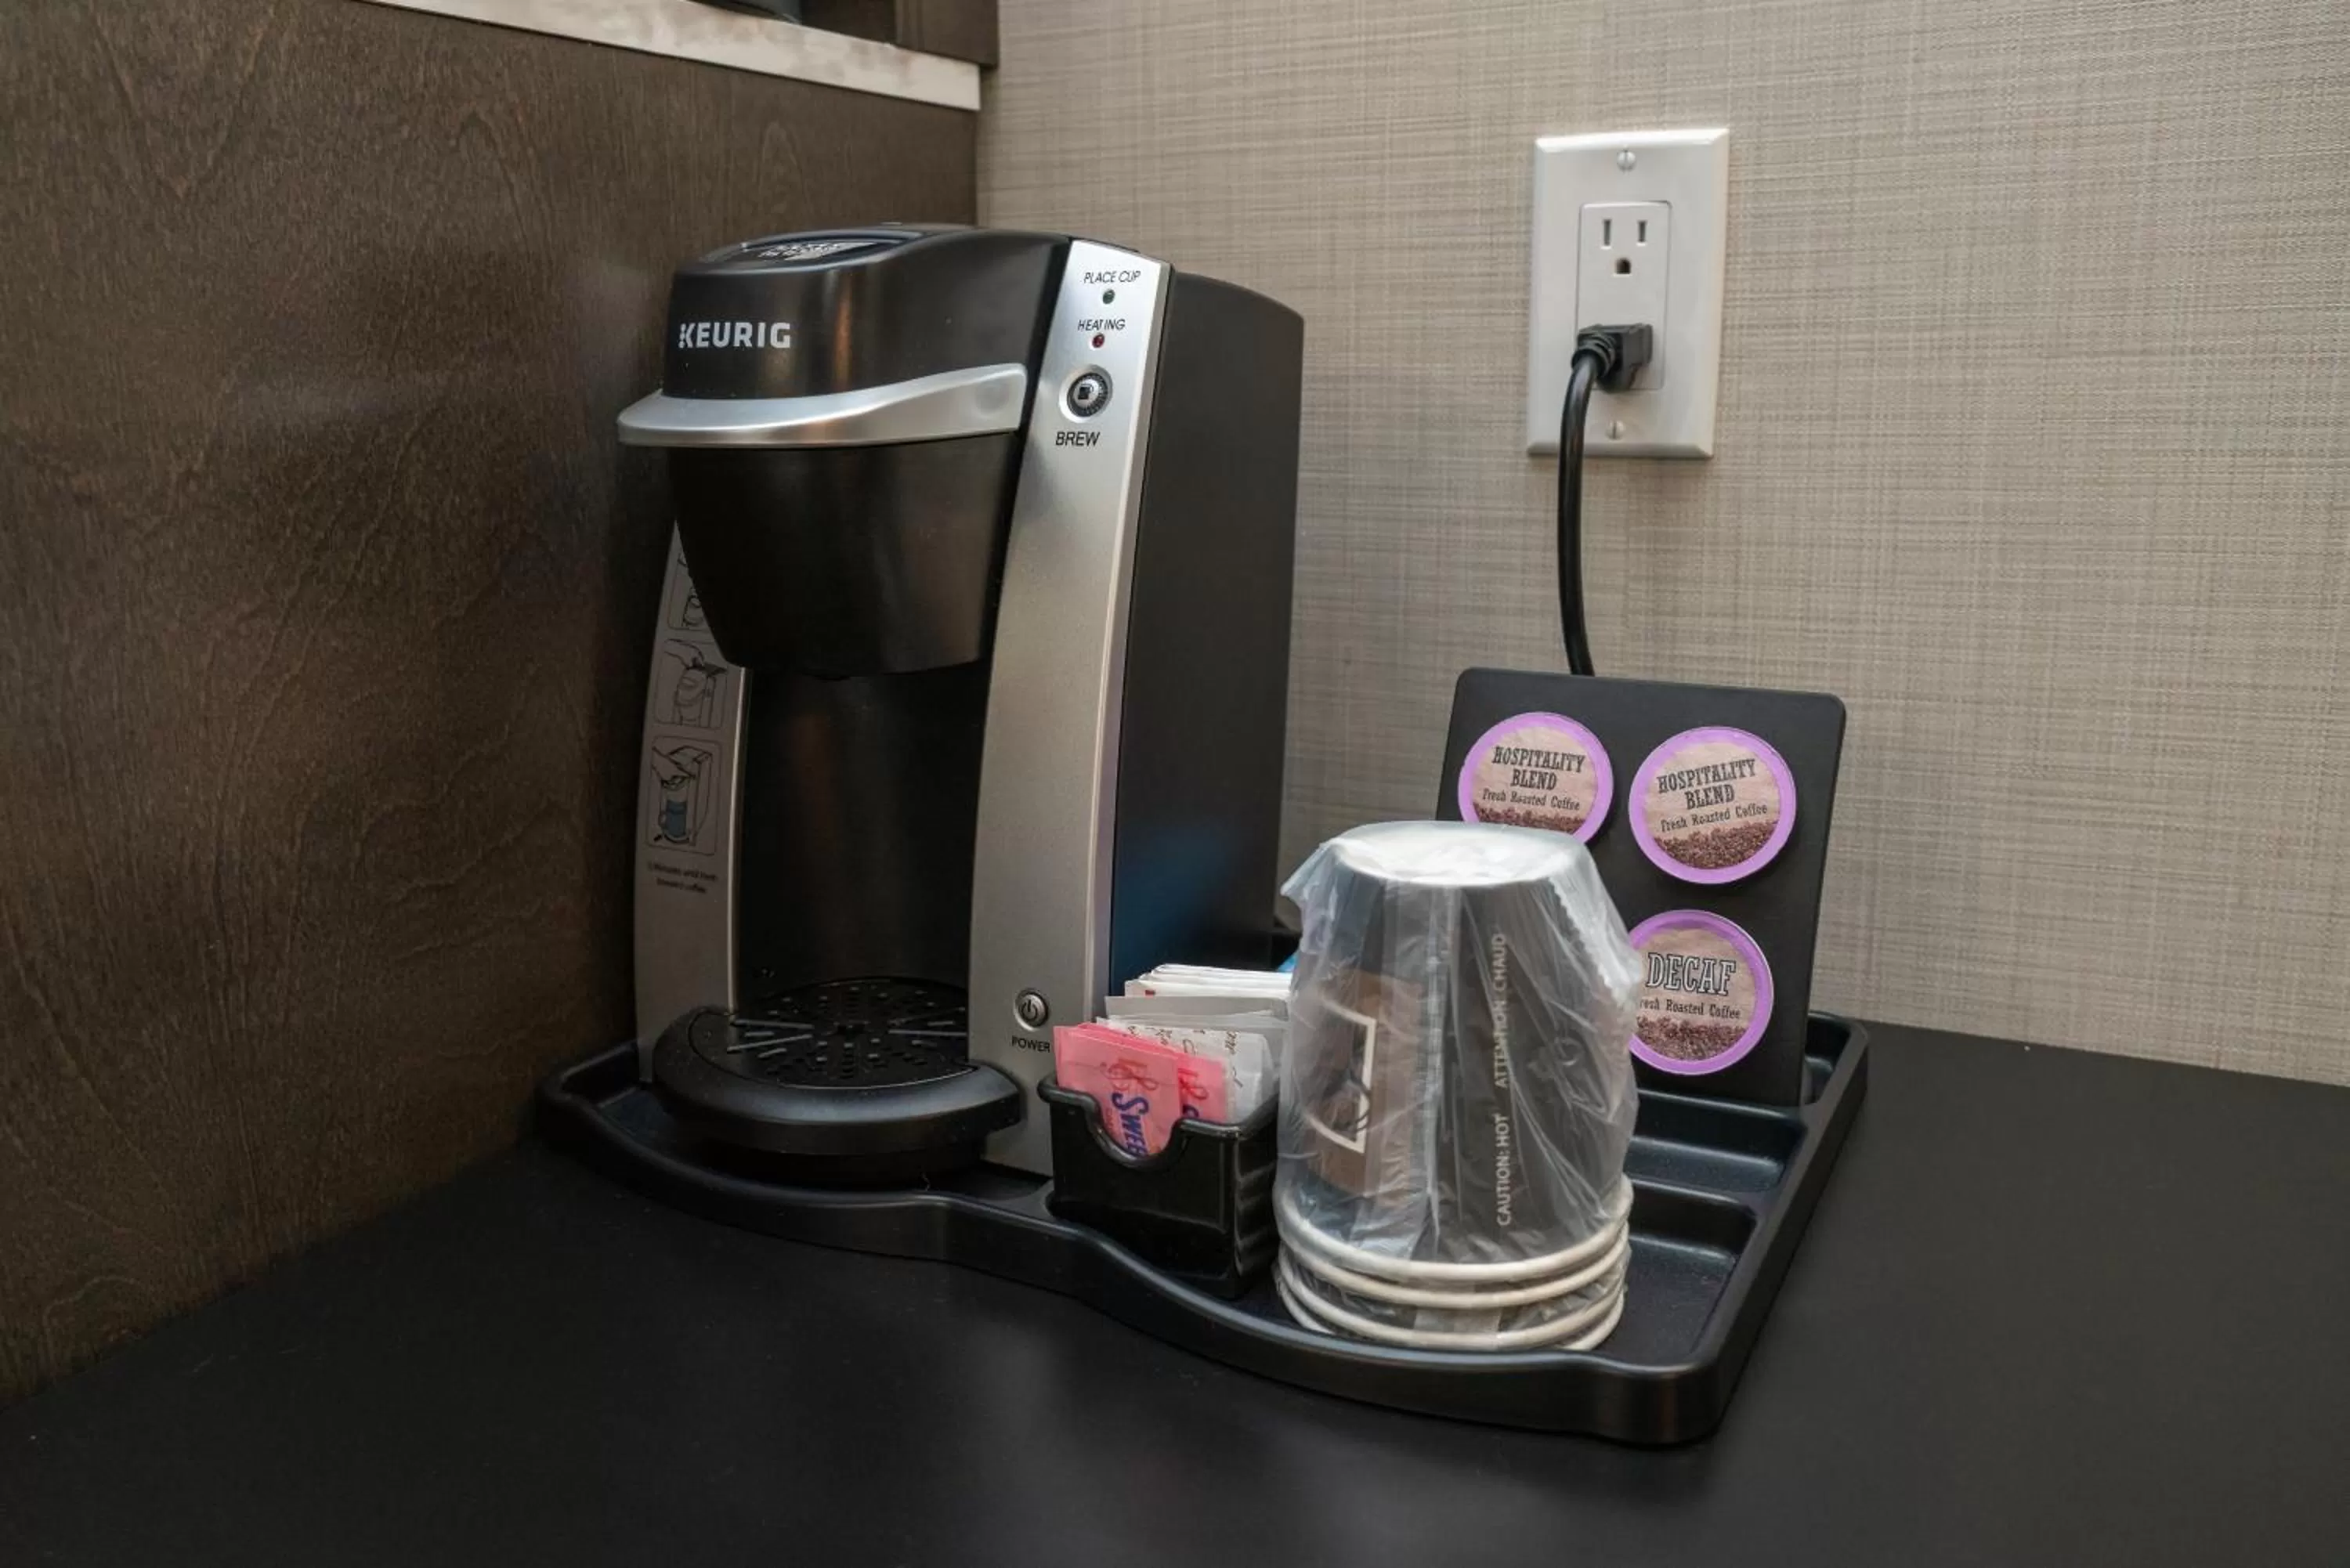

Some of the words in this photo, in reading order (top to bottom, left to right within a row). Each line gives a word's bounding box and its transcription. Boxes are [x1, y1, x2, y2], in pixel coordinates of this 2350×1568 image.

[1084, 271, 1116, 284] PLACE
[1118, 270, 1141, 283] CUP
[678, 321, 791, 349] KEURIG
[1077, 319, 1126, 331] HEATING
[1055, 432, 1101, 447] BREW
[1491, 746, 1585, 773] HOSPITALITY
[1510, 768, 1557, 790] BLEND
[1657, 758, 1755, 793] HOSPITALITY
[1483, 787, 1506, 802] Fresh
[1510, 790, 1546, 807] Roasted
[1551, 795, 1581, 811] Coffee
[1685, 784, 1735, 810] BLEND
[1661, 816, 1688, 833] Fresh
[1690, 807, 1730, 826] Roasted
[1735, 803, 1768, 818] Coffee
[1491, 933, 1507, 992] CHAUD
[1646, 952, 1737, 996] DECAF
[1639, 996, 1660, 1010] resh
[1666, 999, 1705, 1016] Roasted
[1708, 1003, 1741, 1019] Coffee
[1011, 1035, 1050, 1053] POWER
[1492, 1000, 1509, 1089] ATTENTION
[1494, 1112, 1510, 1147] HOT
